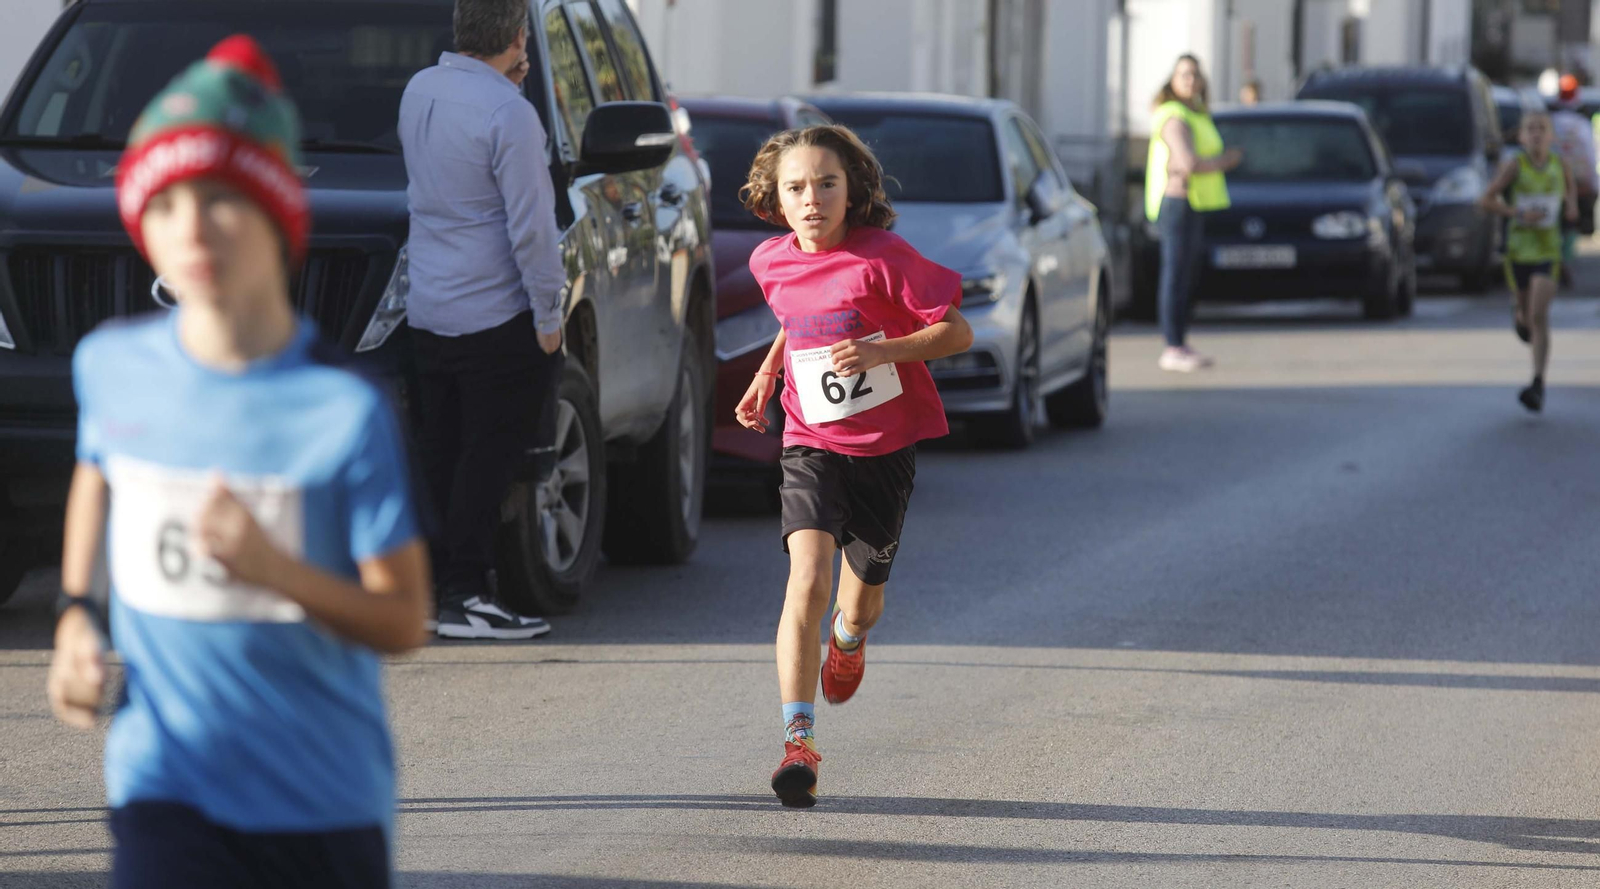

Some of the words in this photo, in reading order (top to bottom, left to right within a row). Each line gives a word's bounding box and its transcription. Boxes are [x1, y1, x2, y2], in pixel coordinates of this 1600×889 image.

[784, 309, 860, 328] ATLETISMO
[796, 353, 827, 363] ASTELLAR
[821, 370, 873, 405] 62
